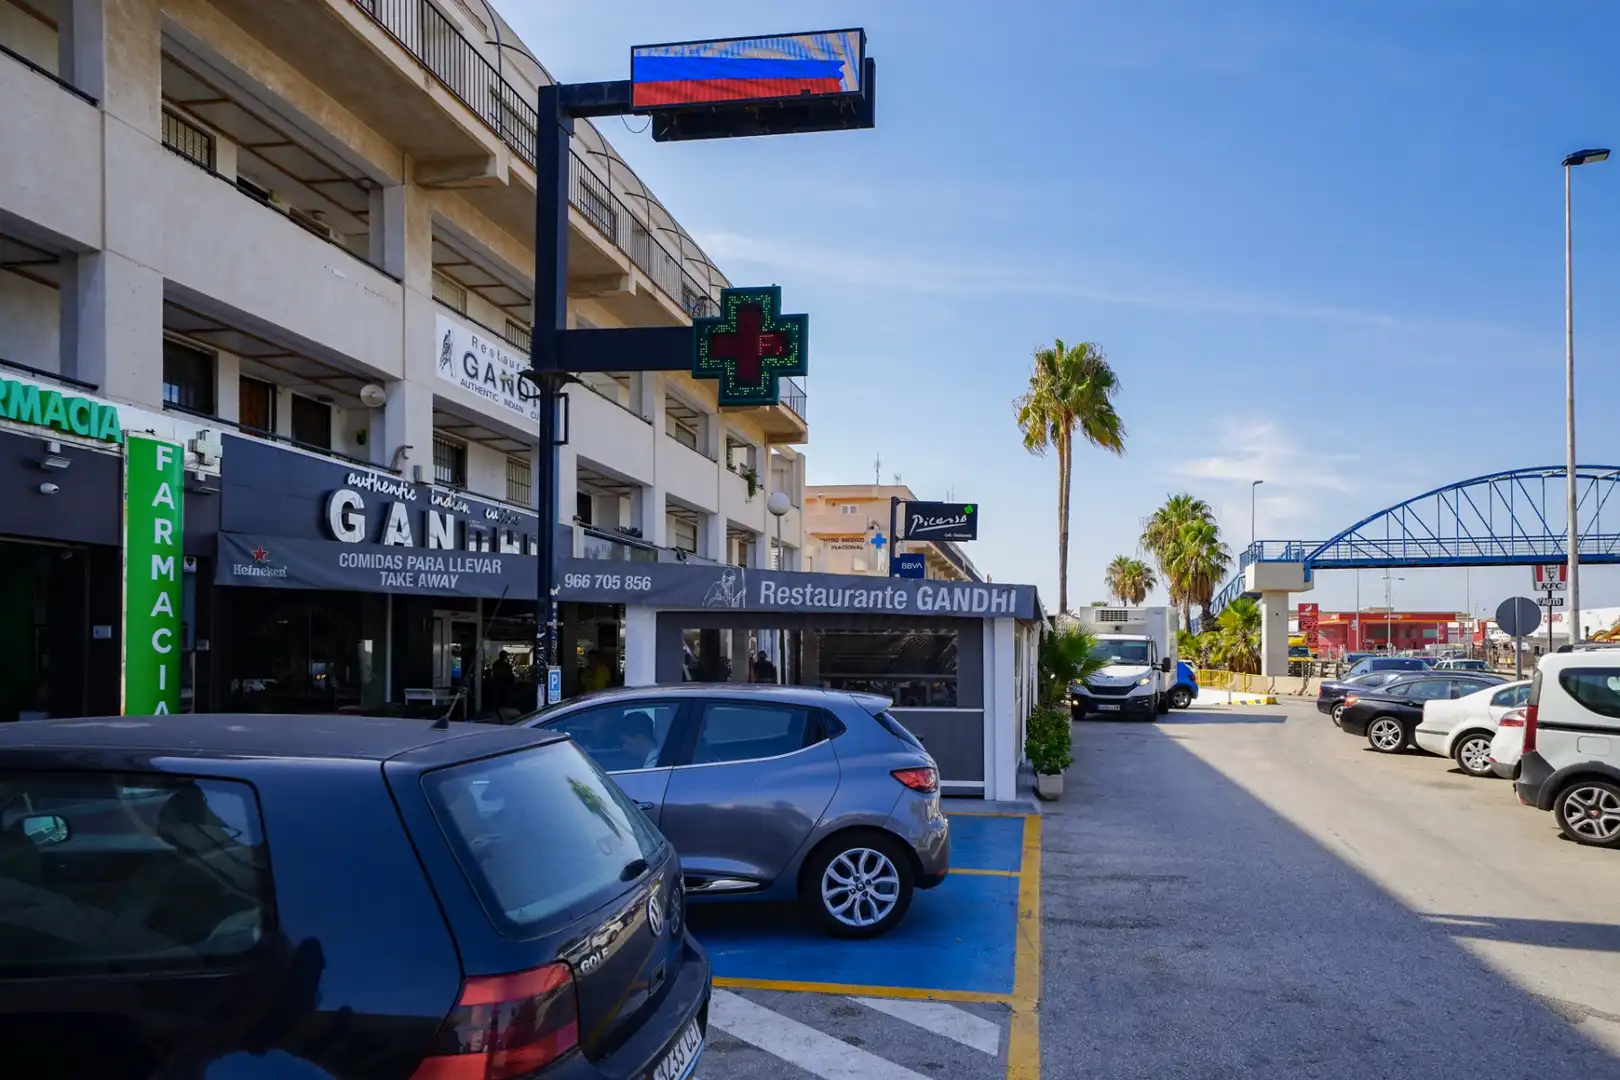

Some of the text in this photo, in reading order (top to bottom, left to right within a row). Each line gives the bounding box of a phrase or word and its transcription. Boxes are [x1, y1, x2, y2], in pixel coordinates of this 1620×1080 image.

[471, 335, 529, 371] Restaur
[460, 379, 524, 414] AUTHENTIC INDIAN
[347, 472, 417, 501] authentic
[430, 489, 471, 514] indian
[909, 514, 967, 536] Picasso
[232, 564, 287, 578] Heineken
[339, 553, 502, 574] COMIDAS PARA LLEVAR
[380, 571, 459, 589] TAKE AWAY
[564, 573, 652, 591] 966 705 856
[760, 580, 1017, 613] Restaurante GANDHI
[551, 674, 558, 689] P
[580, 948, 609, 972] GOLF
